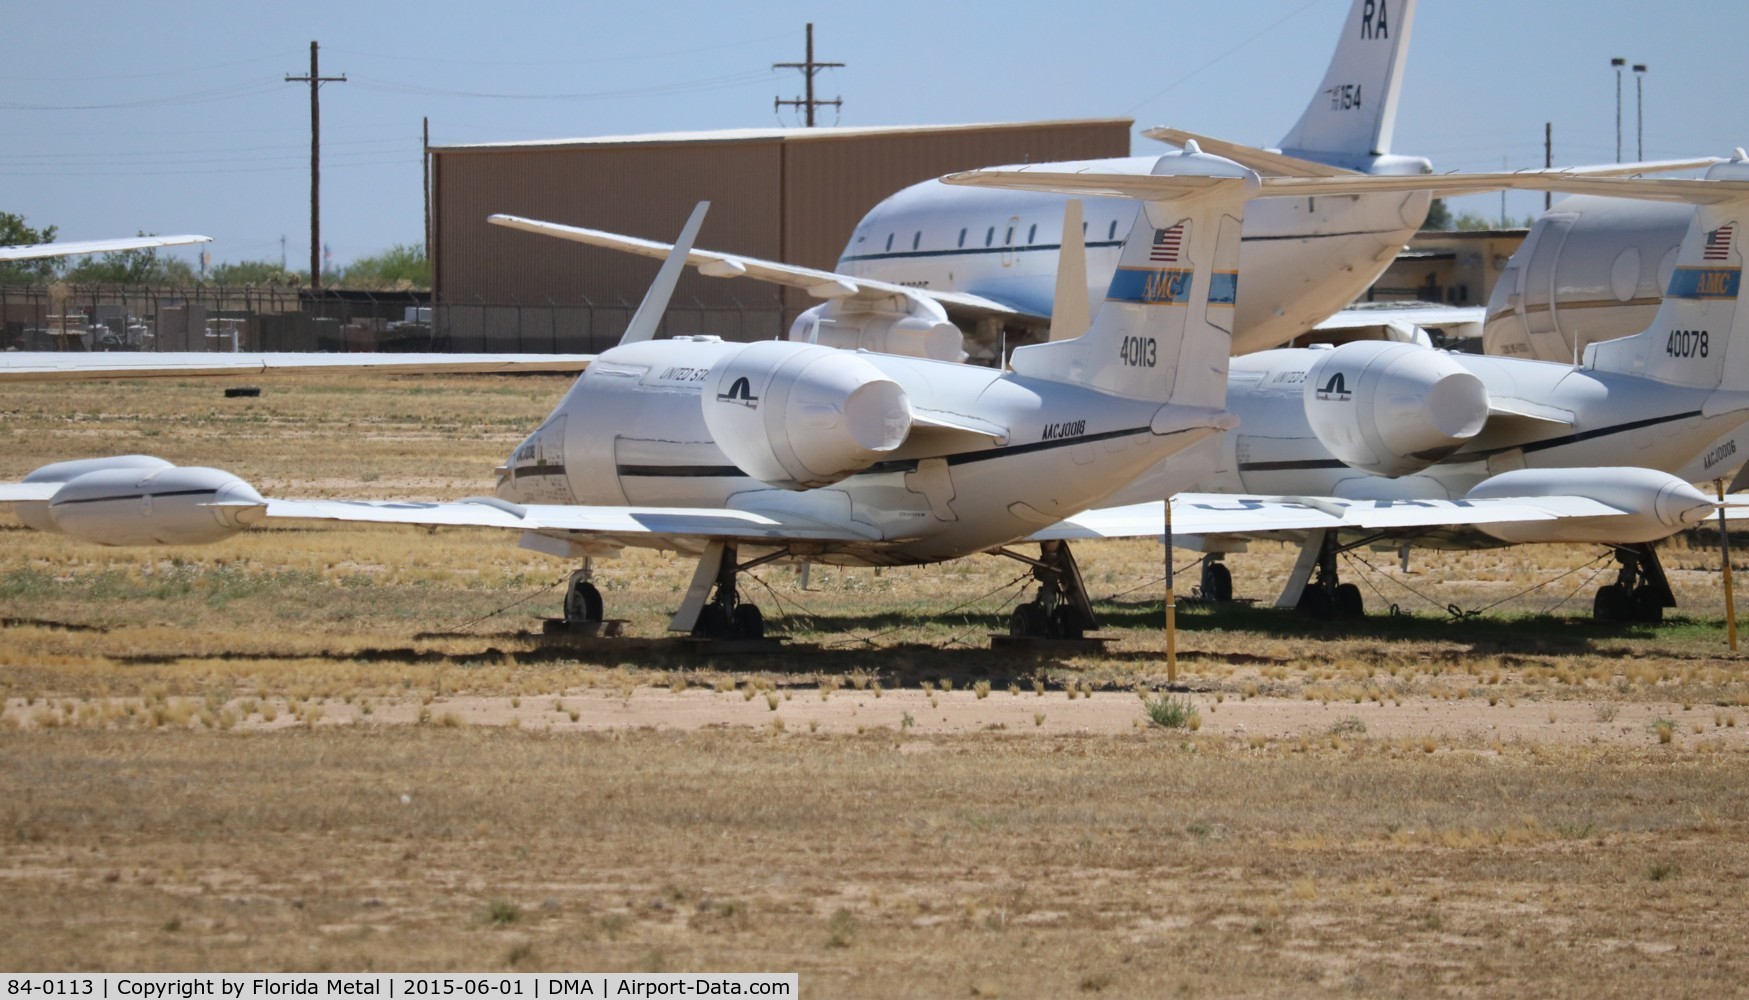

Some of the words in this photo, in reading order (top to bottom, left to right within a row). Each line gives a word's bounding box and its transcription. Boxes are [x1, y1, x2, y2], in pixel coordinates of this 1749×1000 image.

[1360, 0, 1388, 40] RA
[1142, 273, 1180, 298] AMC
[1696, 271, 1730, 294] AMC
[1120, 336, 1157, 367] 40113
[1666, 330, 1709, 358] 40078
[659, 367, 695, 381] UNITED
[1042, 420, 1086, 441] AACJ0018
[1703, 440, 1737, 470] AACJ0006
